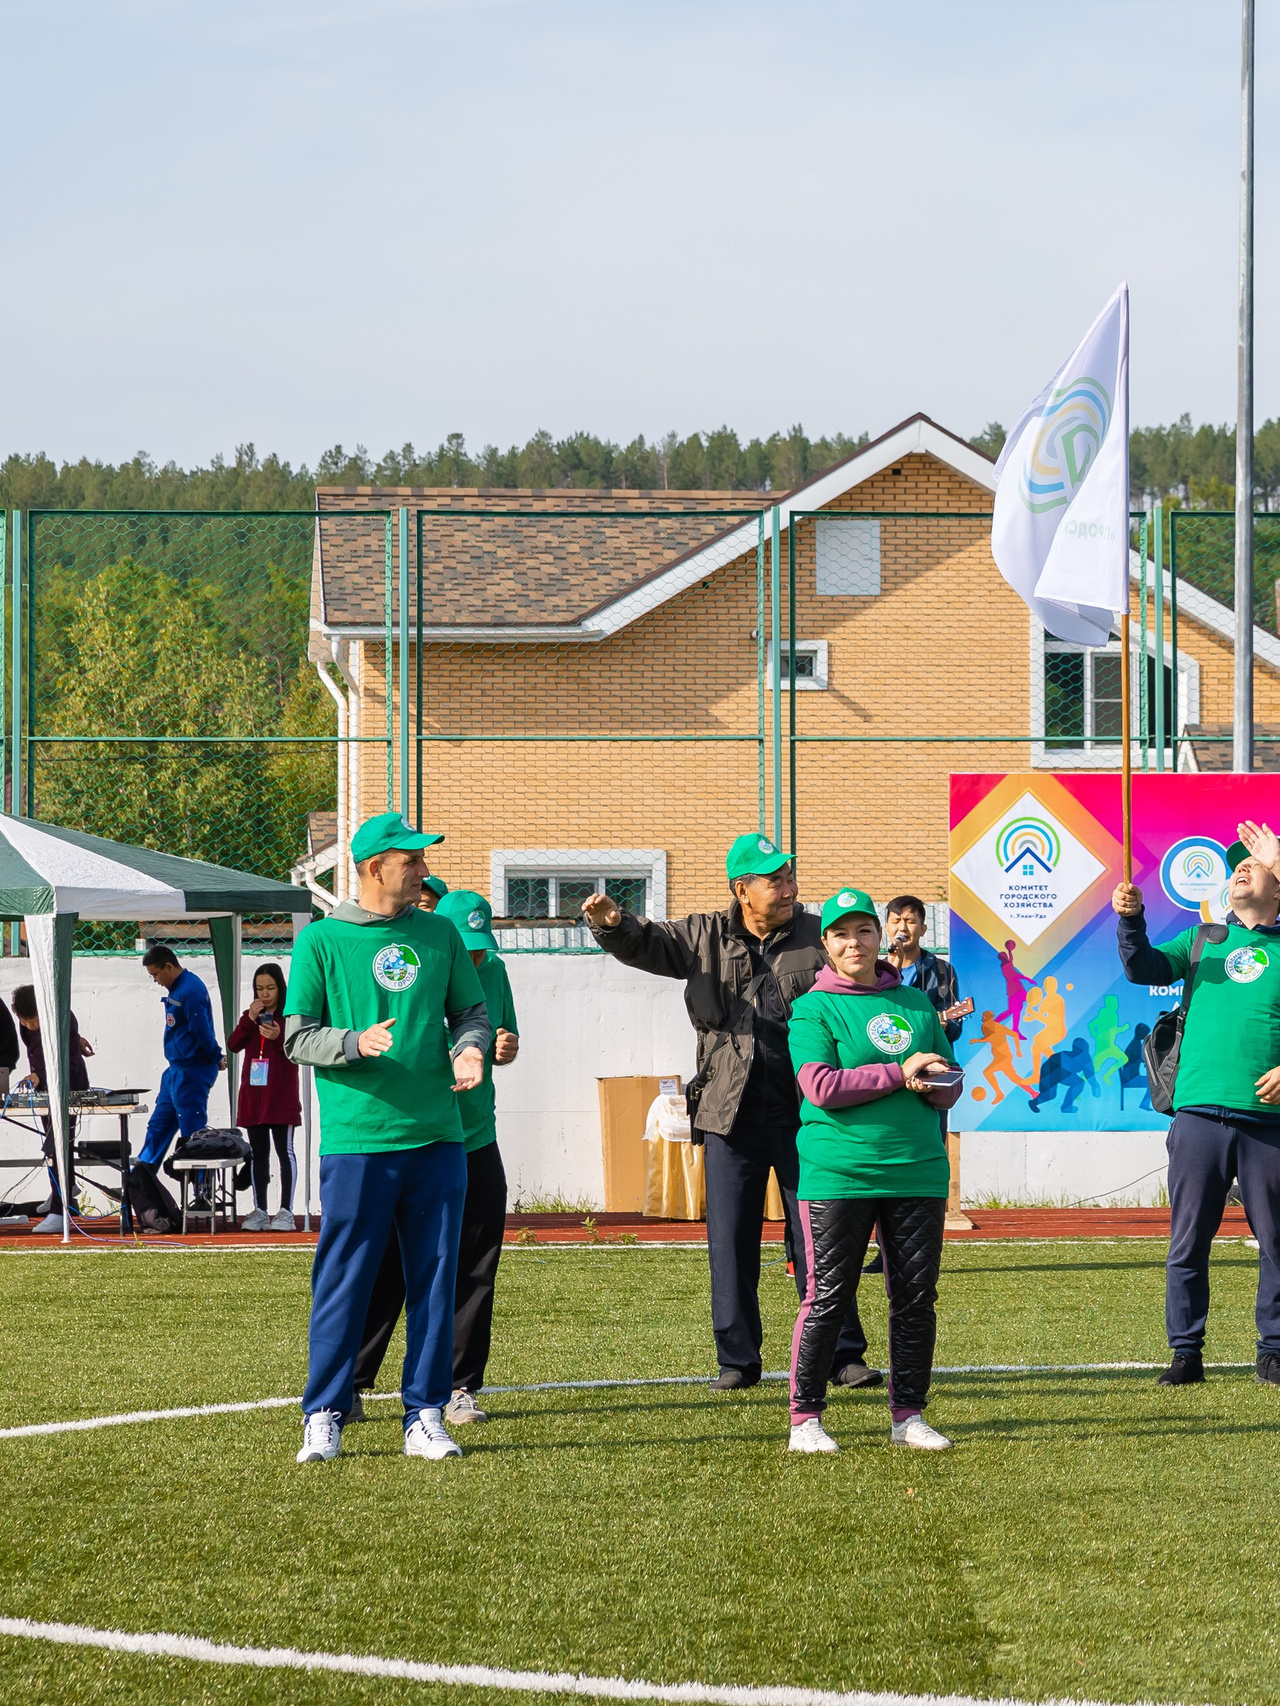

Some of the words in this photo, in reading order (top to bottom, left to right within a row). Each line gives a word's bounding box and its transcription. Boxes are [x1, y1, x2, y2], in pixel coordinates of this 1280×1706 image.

[1000, 893, 1058, 901] ГОРОДСКОГО
[1003, 900, 1054, 909] ХОЗЯЙСТВА
[393, 971, 415, 988] ГОРОД
